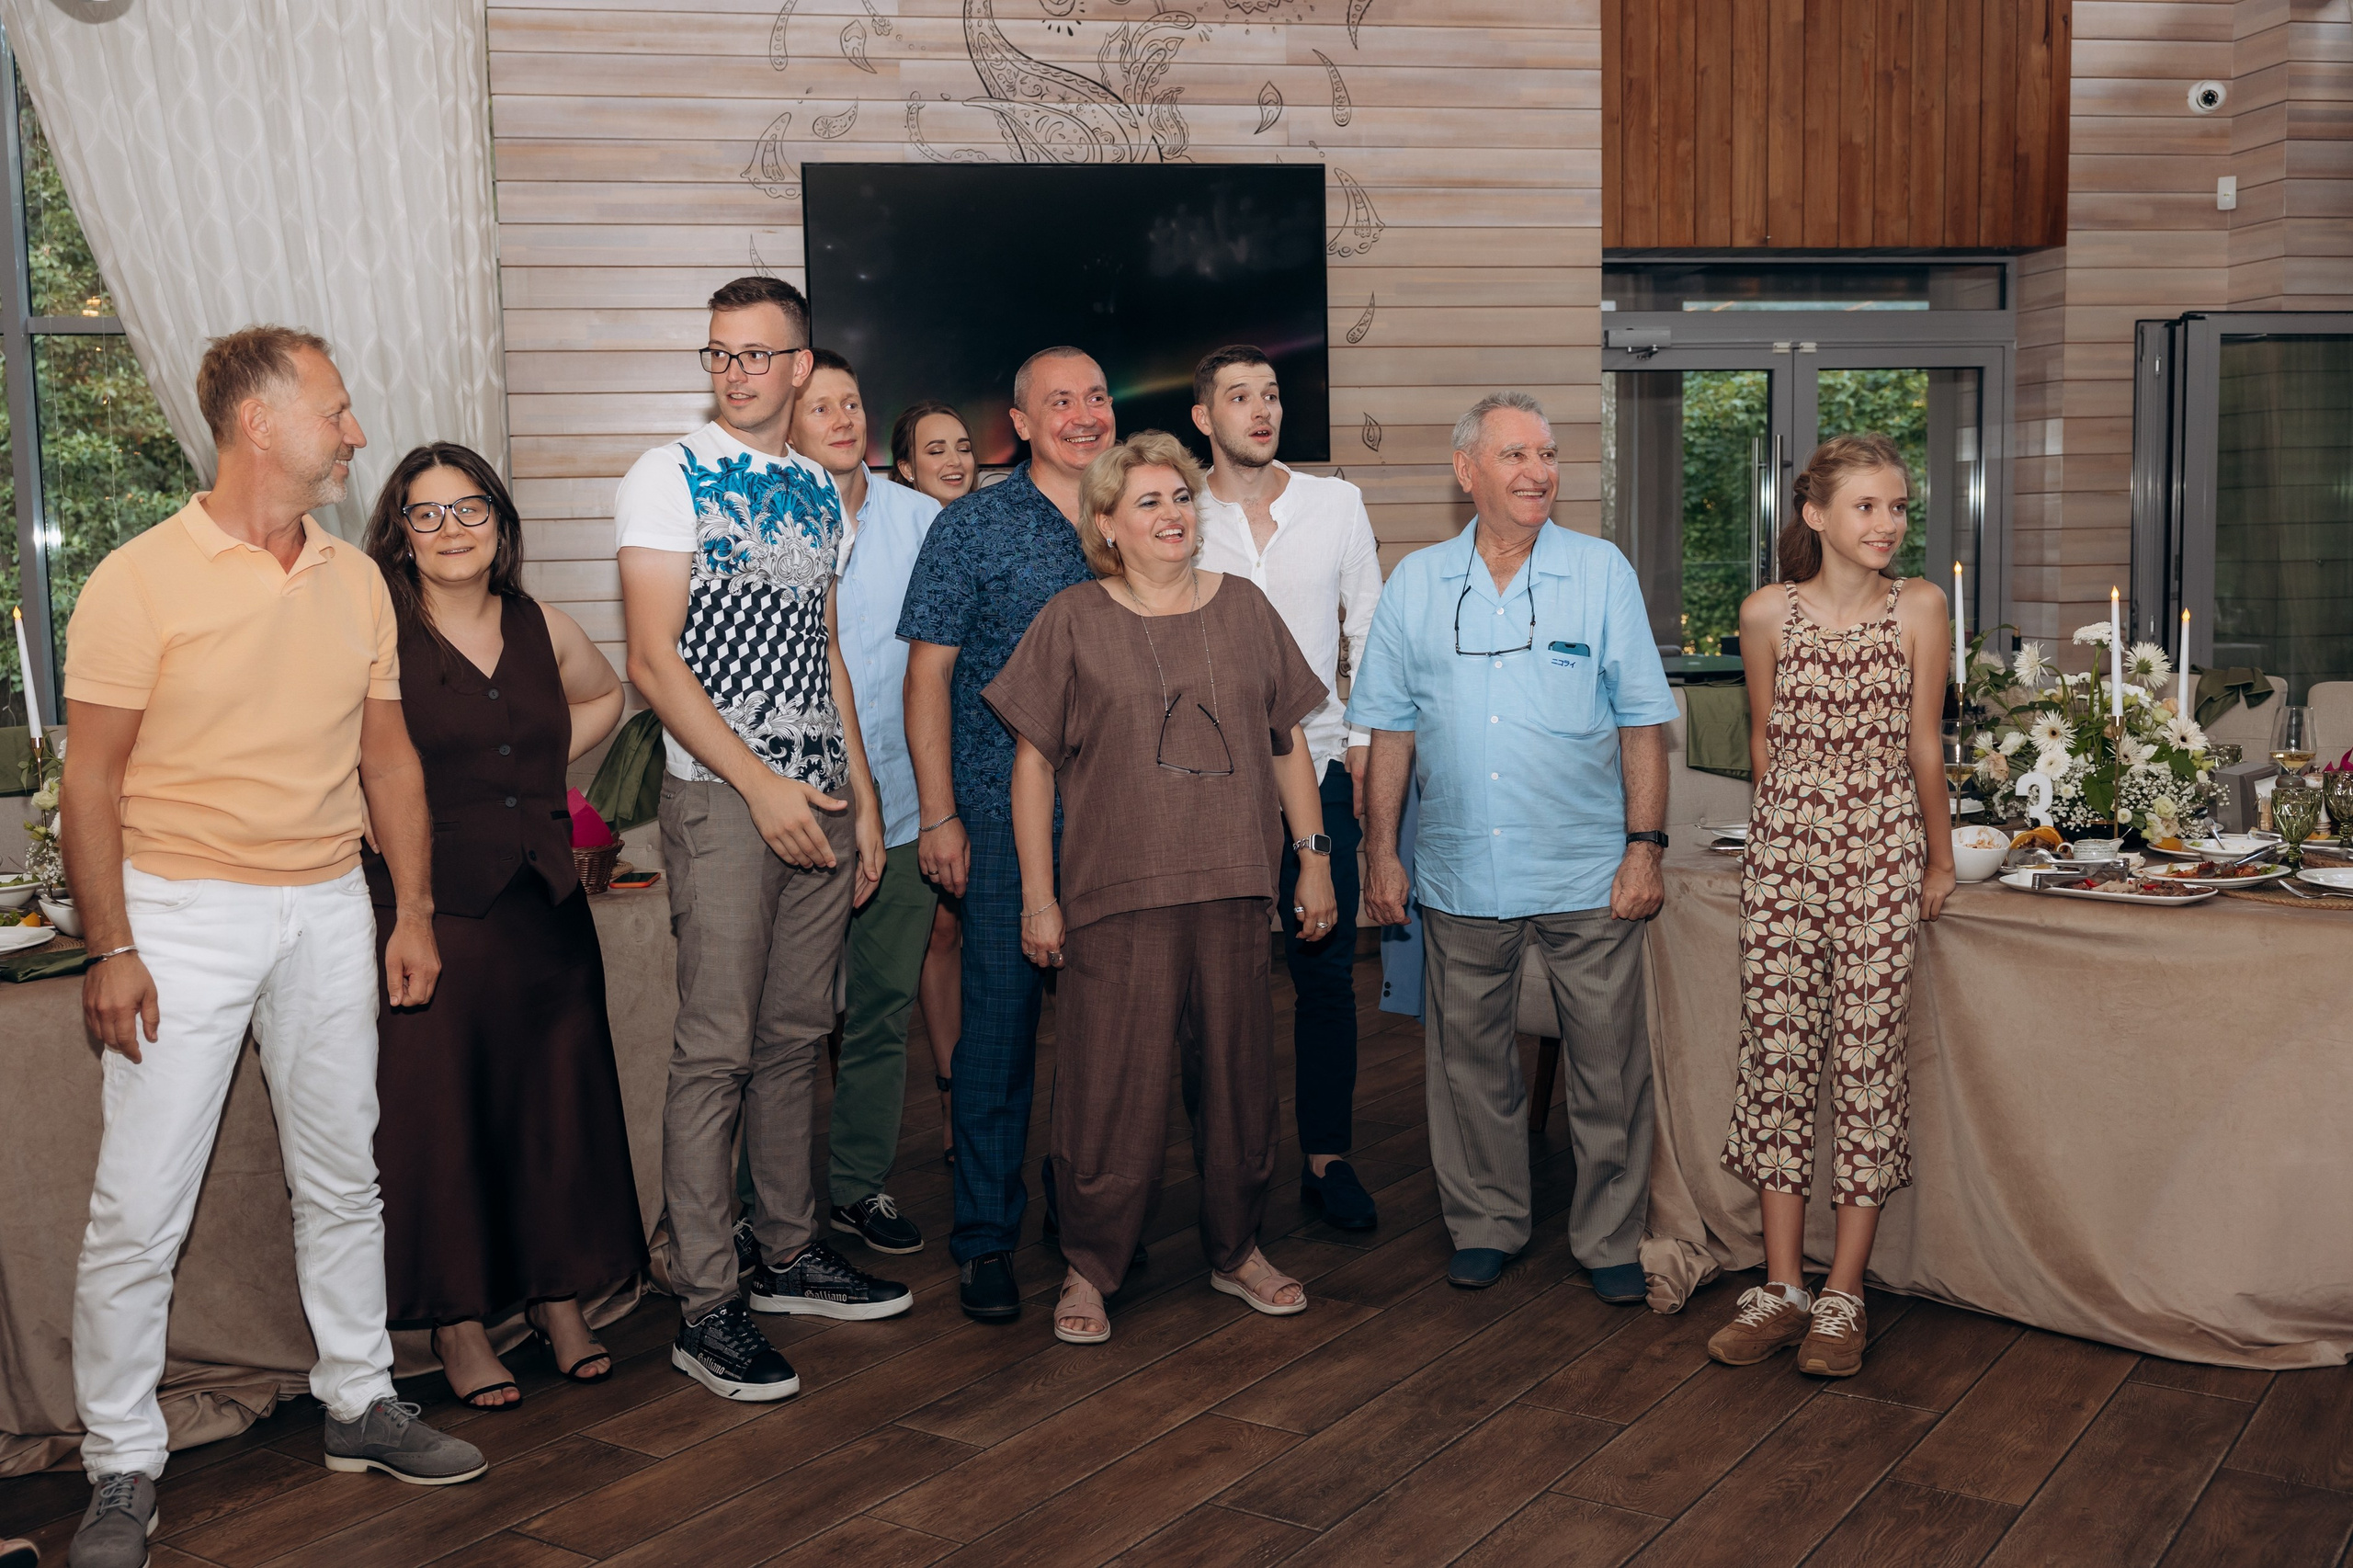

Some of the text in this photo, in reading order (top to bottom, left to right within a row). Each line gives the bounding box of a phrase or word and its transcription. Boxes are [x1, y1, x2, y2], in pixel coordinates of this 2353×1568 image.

[1552, 658, 1575, 668] ニコライ
[2016, 772, 2054, 827] 3
[804, 1290, 847, 1302] Galliano
[697, 1352, 725, 1375] Galliano
